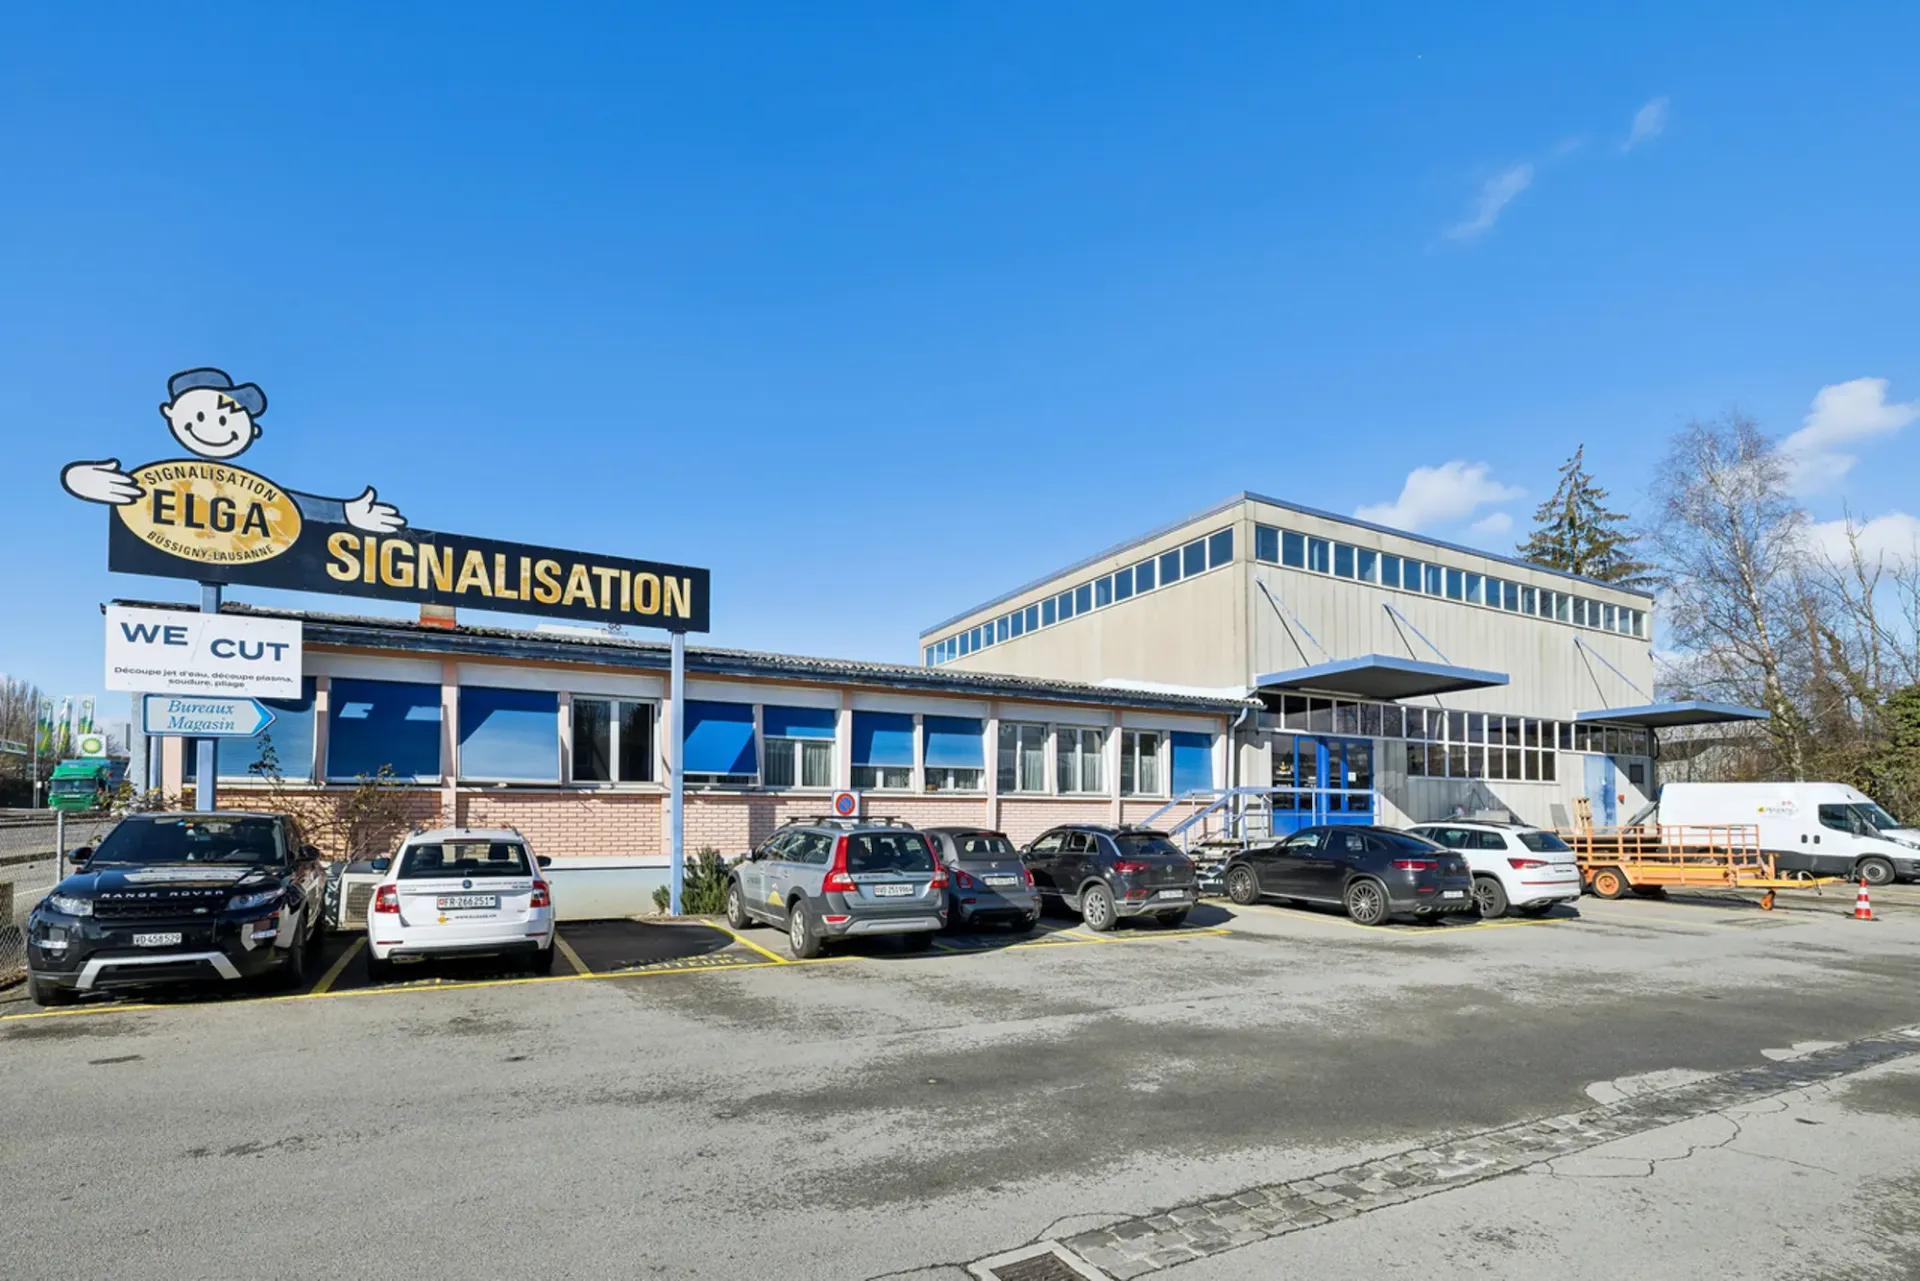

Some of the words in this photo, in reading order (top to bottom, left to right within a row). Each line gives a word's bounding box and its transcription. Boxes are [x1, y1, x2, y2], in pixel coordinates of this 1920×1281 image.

[144, 465, 277, 502] SIGNALISATION
[153, 488, 271, 538] ELGA
[325, 531, 691, 619] SIGNALISATION
[120, 622, 189, 646] WE
[210, 638, 289, 661] CUT
[114, 666, 161, 677] Découpe
[163, 669, 177, 678] jet
[211, 671, 254, 681] découpe
[214, 680, 245, 689] pliage
[167, 699, 235, 715] Bureaux
[167, 715, 235, 732] Magasin
